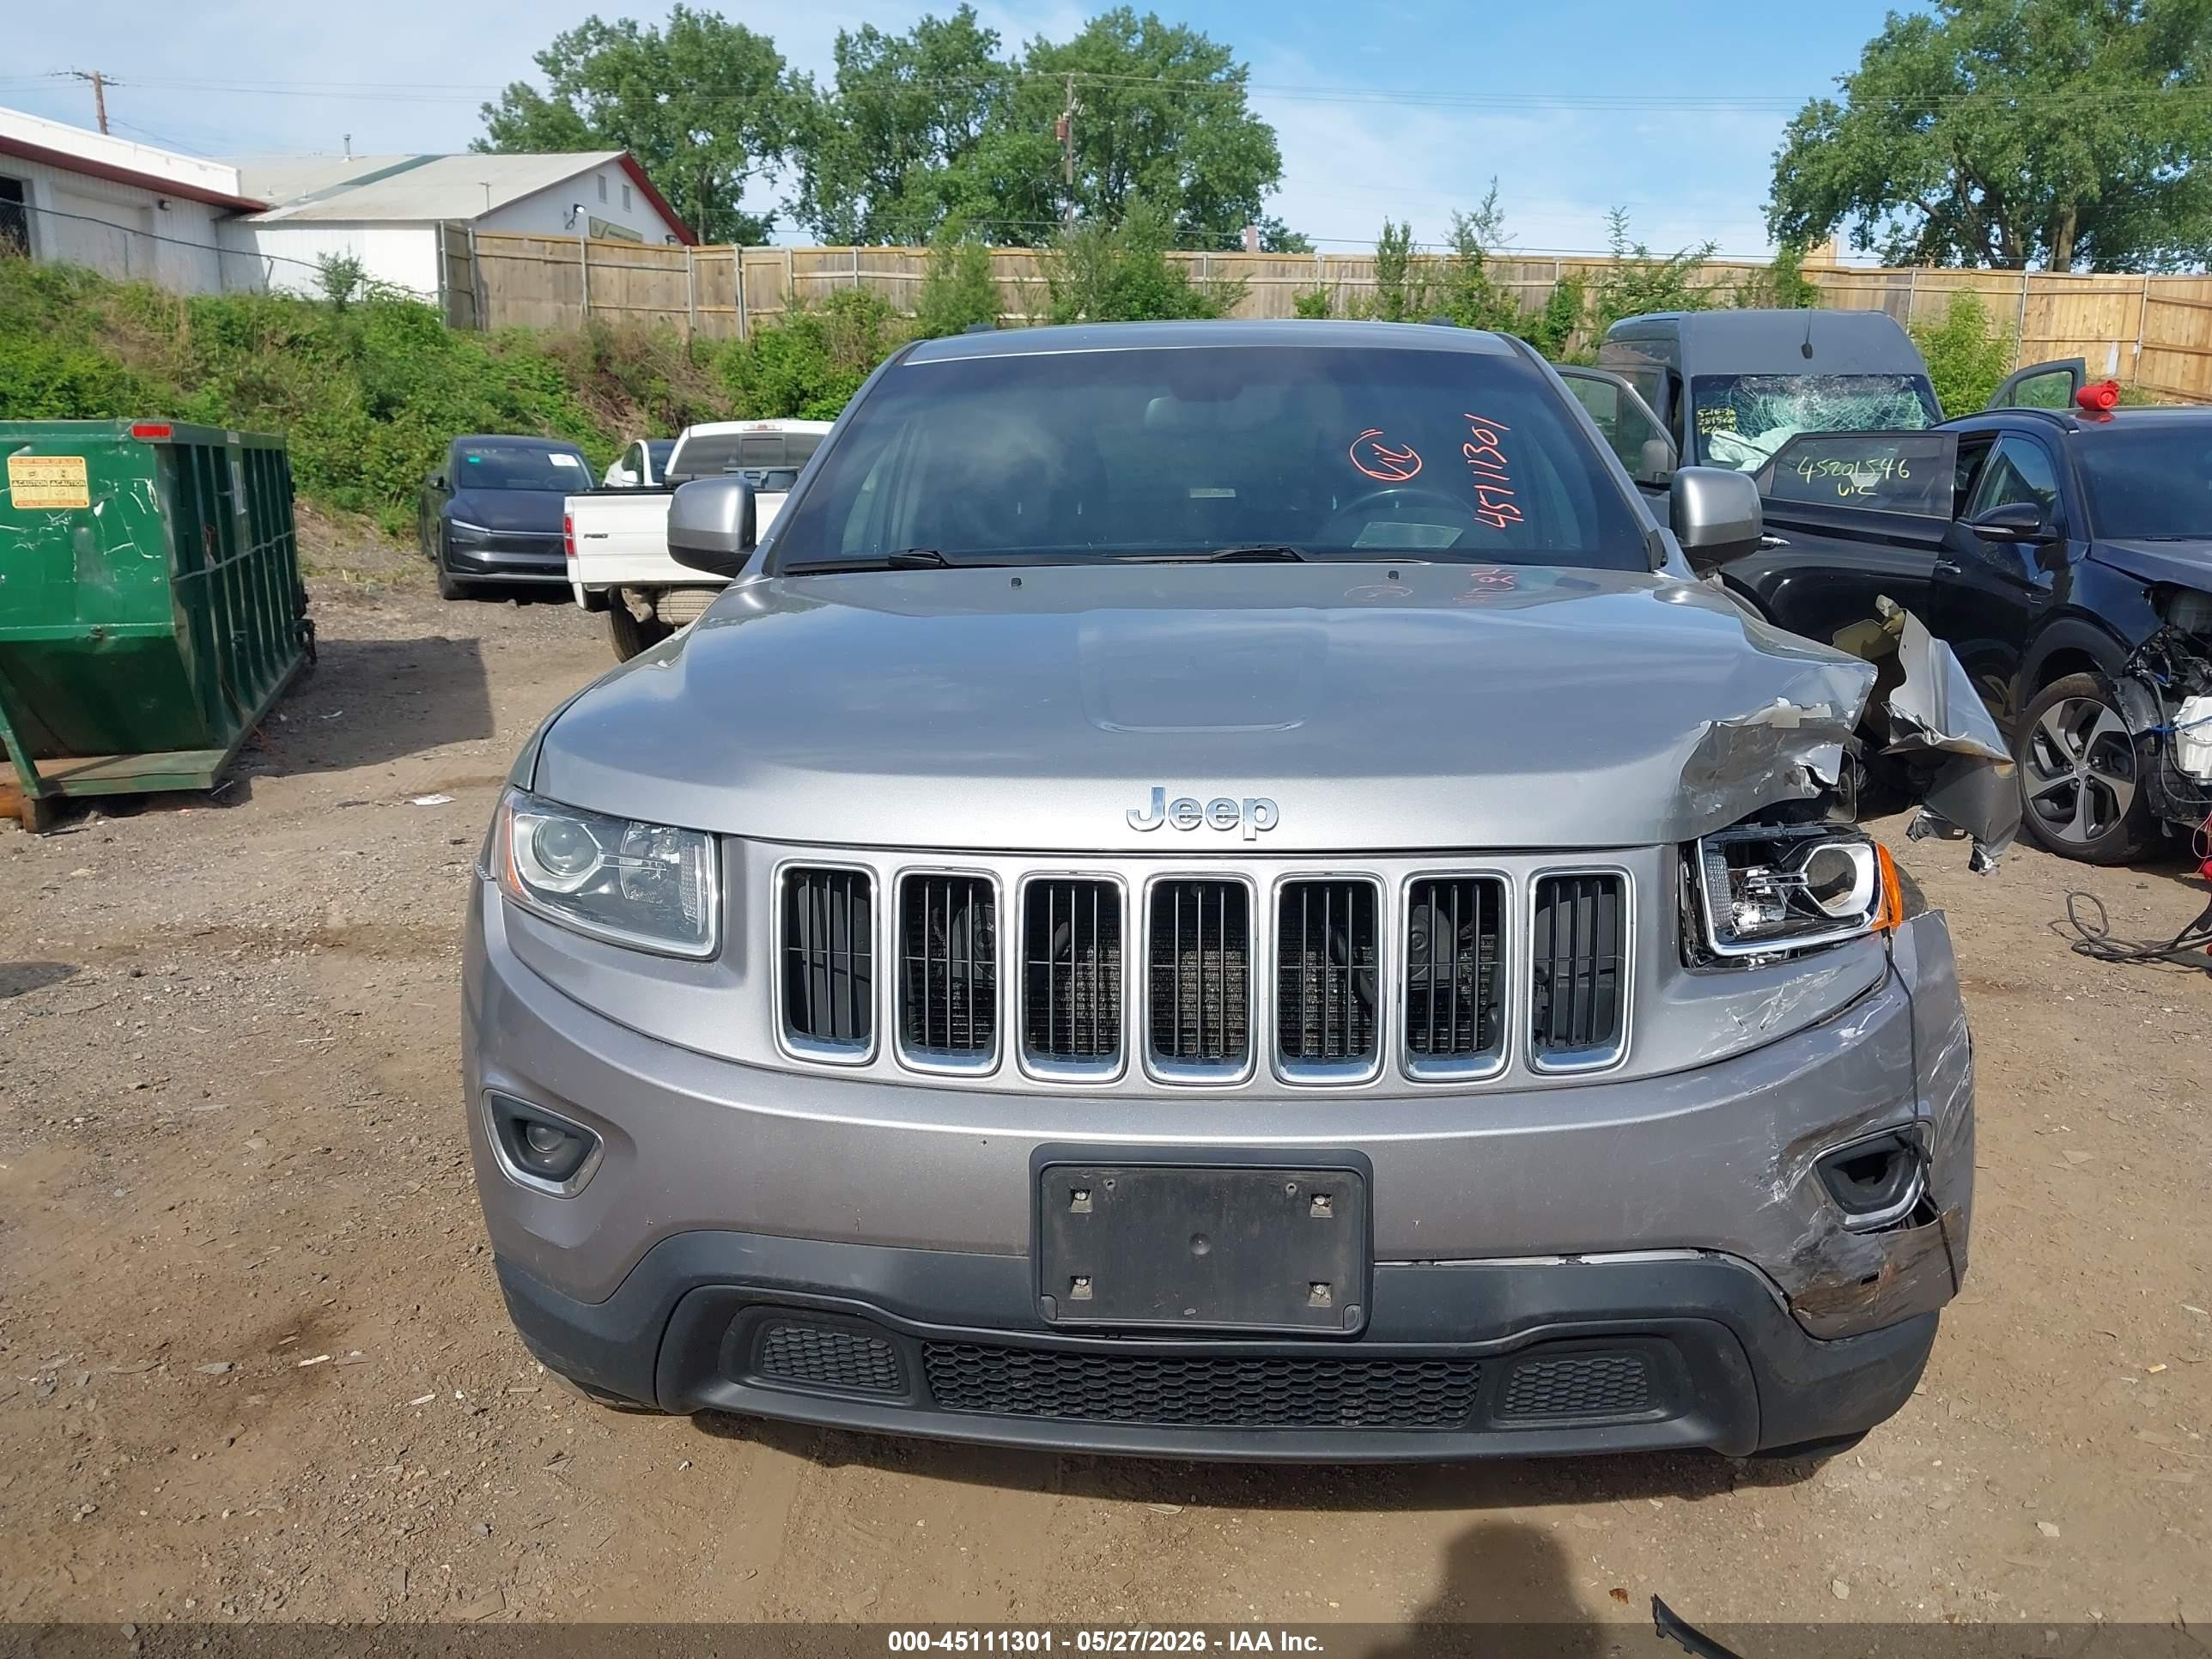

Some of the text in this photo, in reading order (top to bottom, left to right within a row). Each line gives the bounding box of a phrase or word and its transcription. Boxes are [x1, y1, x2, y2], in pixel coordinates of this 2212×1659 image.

[1463, 413, 1525, 528] 45111301
[1797, 456, 1910, 483] 45201546
[1127, 787, 1279, 842] Jeep
